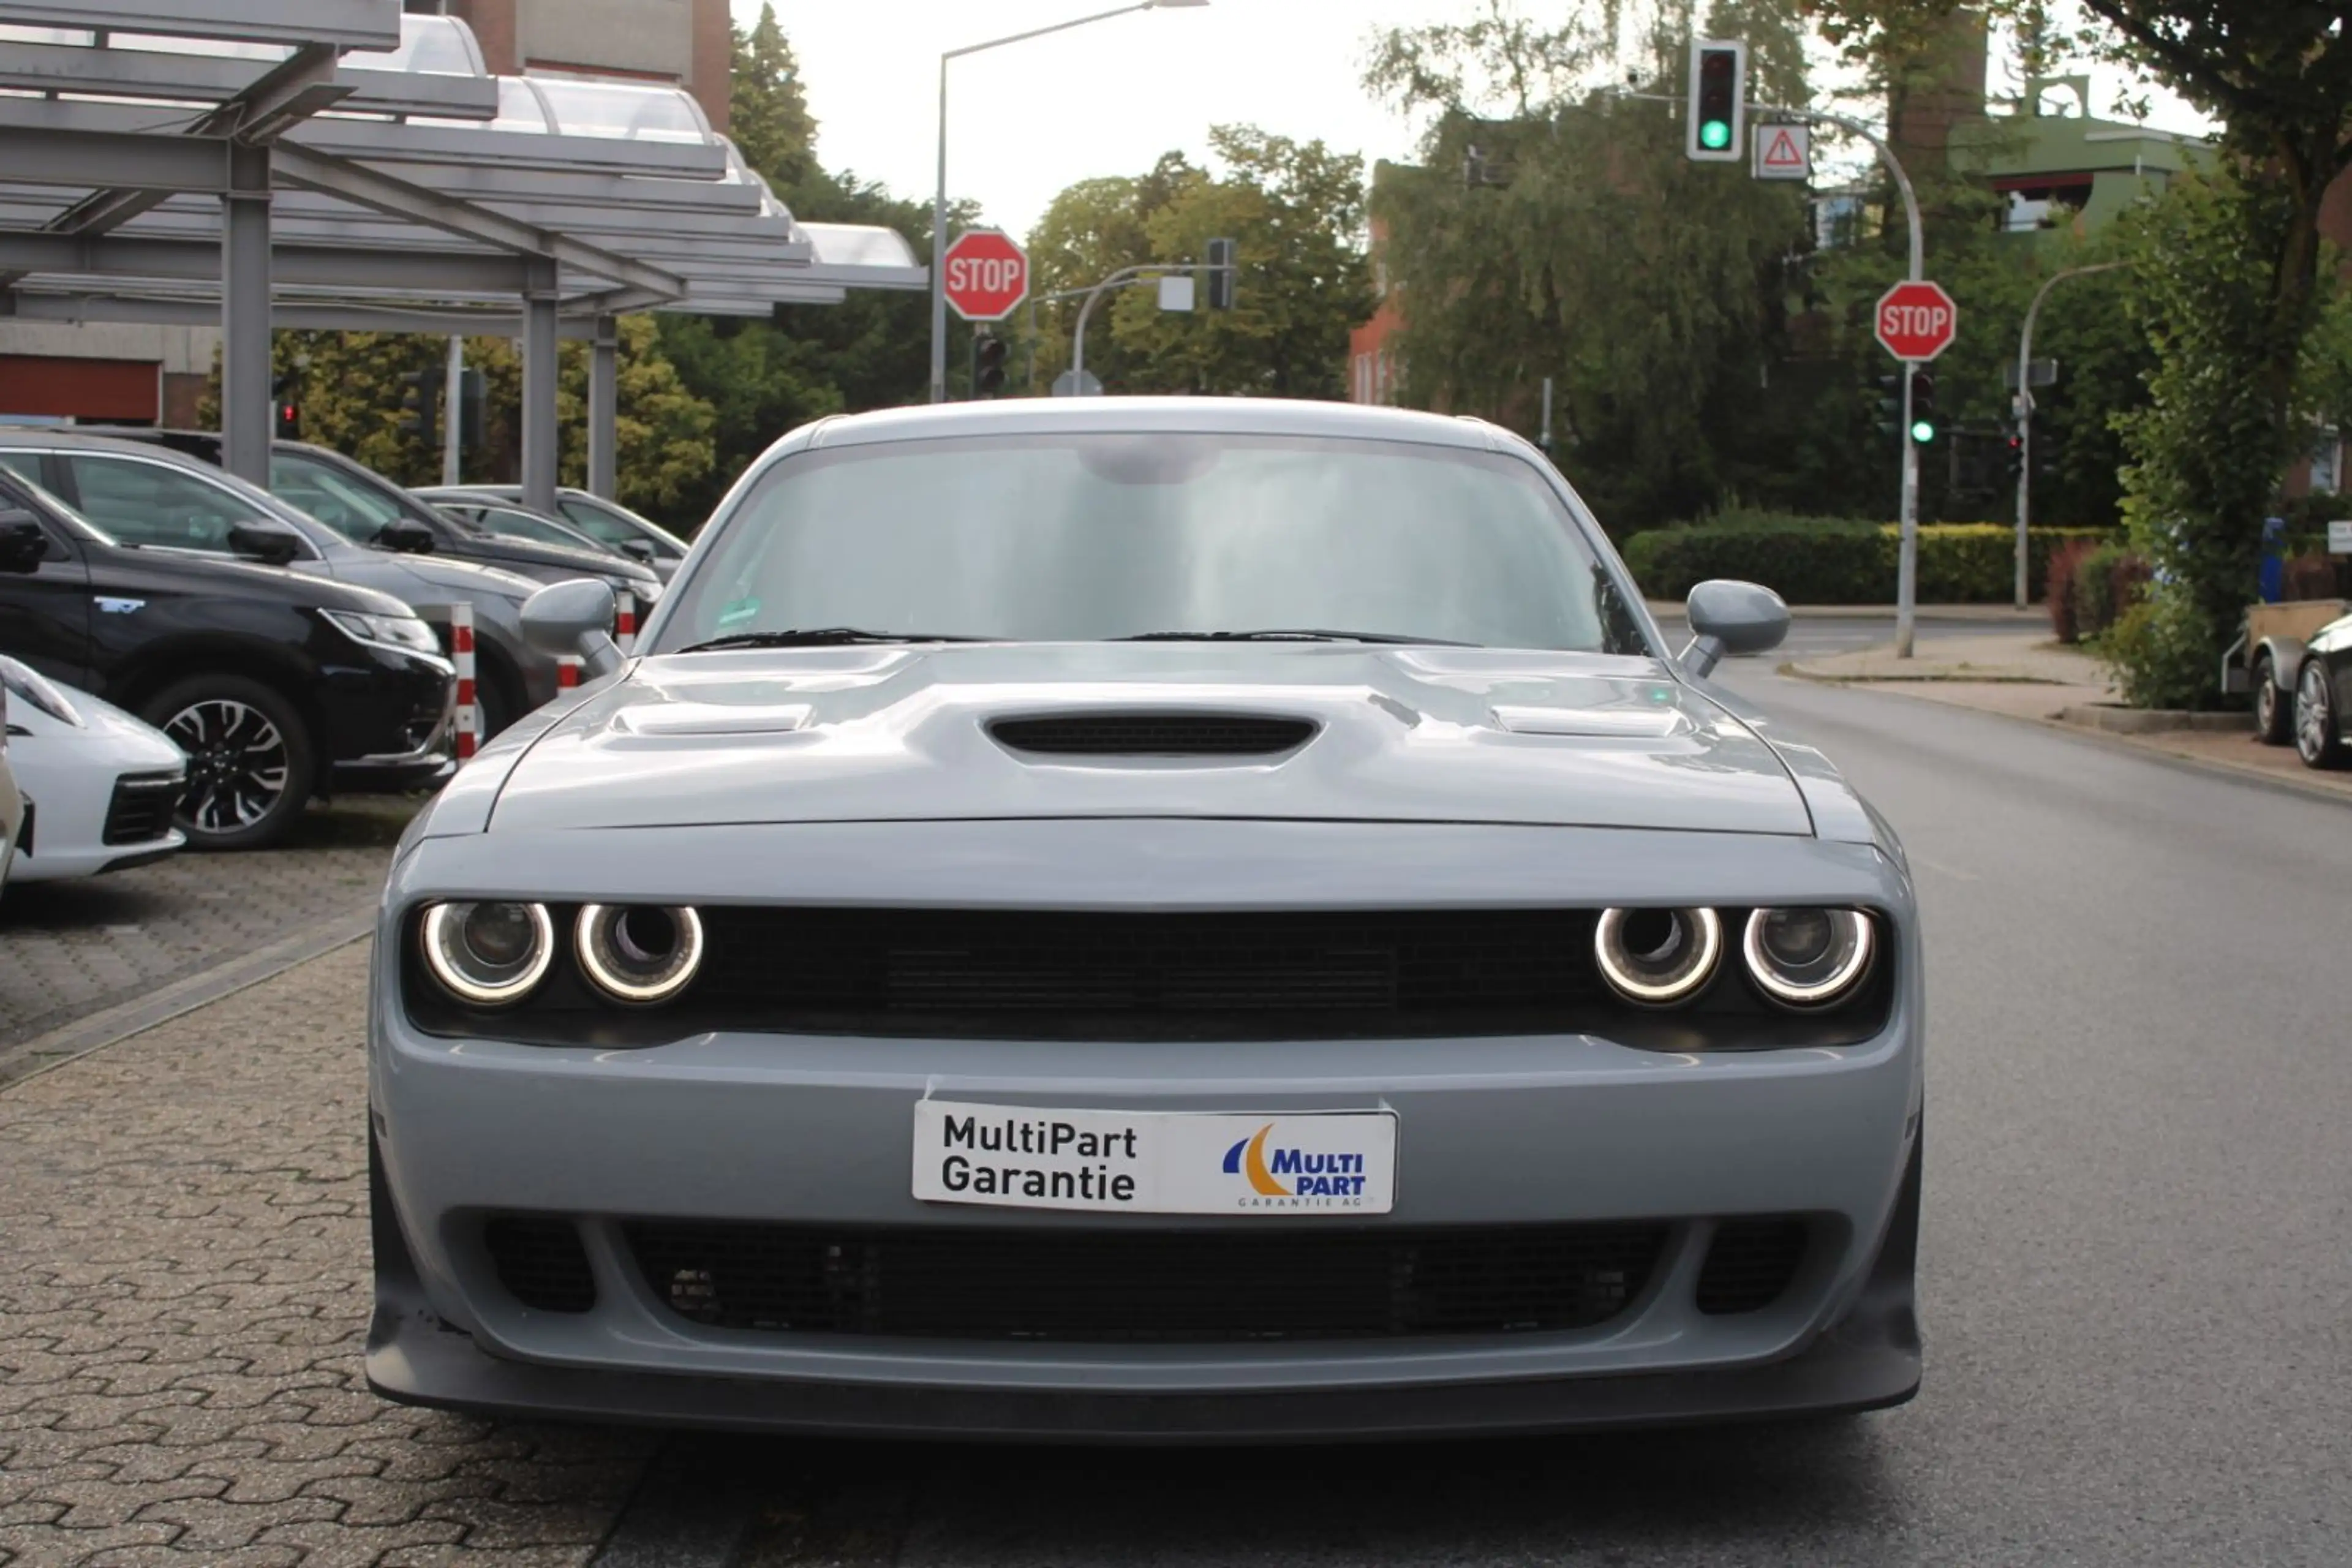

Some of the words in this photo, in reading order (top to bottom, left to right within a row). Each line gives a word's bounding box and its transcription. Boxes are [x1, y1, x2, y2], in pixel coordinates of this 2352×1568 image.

[949, 258, 1019, 292] STOP
[1883, 306, 1947, 336] STOP
[944, 1115, 1136, 1158] MultiPart
[1272, 1149, 1363, 1173] MULTI
[942, 1156, 1135, 1200] Garantie
[1297, 1176, 1365, 1196] PART
[1238, 1198, 1332, 1207] GARANTIE
[1342, 1198, 1361, 1207] AG
